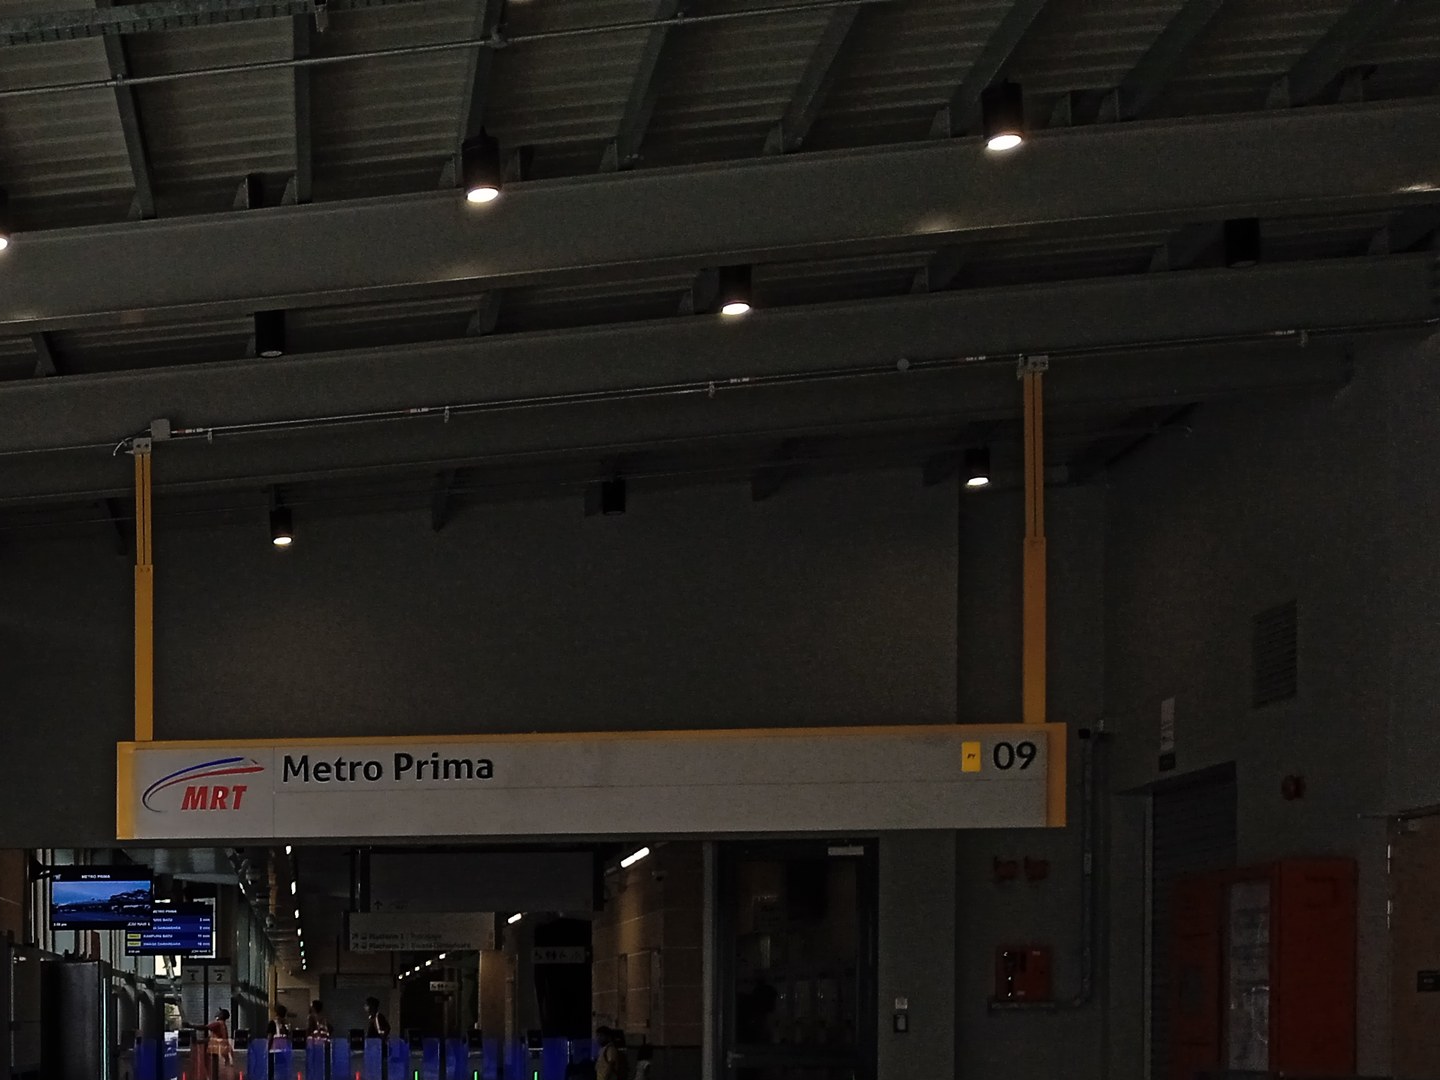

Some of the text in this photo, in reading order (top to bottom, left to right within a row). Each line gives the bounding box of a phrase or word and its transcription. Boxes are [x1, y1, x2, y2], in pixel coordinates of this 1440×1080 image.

[282, 751, 495, 783] Metro Prima
[992, 741, 1038, 771] 09
[181, 785, 248, 811] MRT
